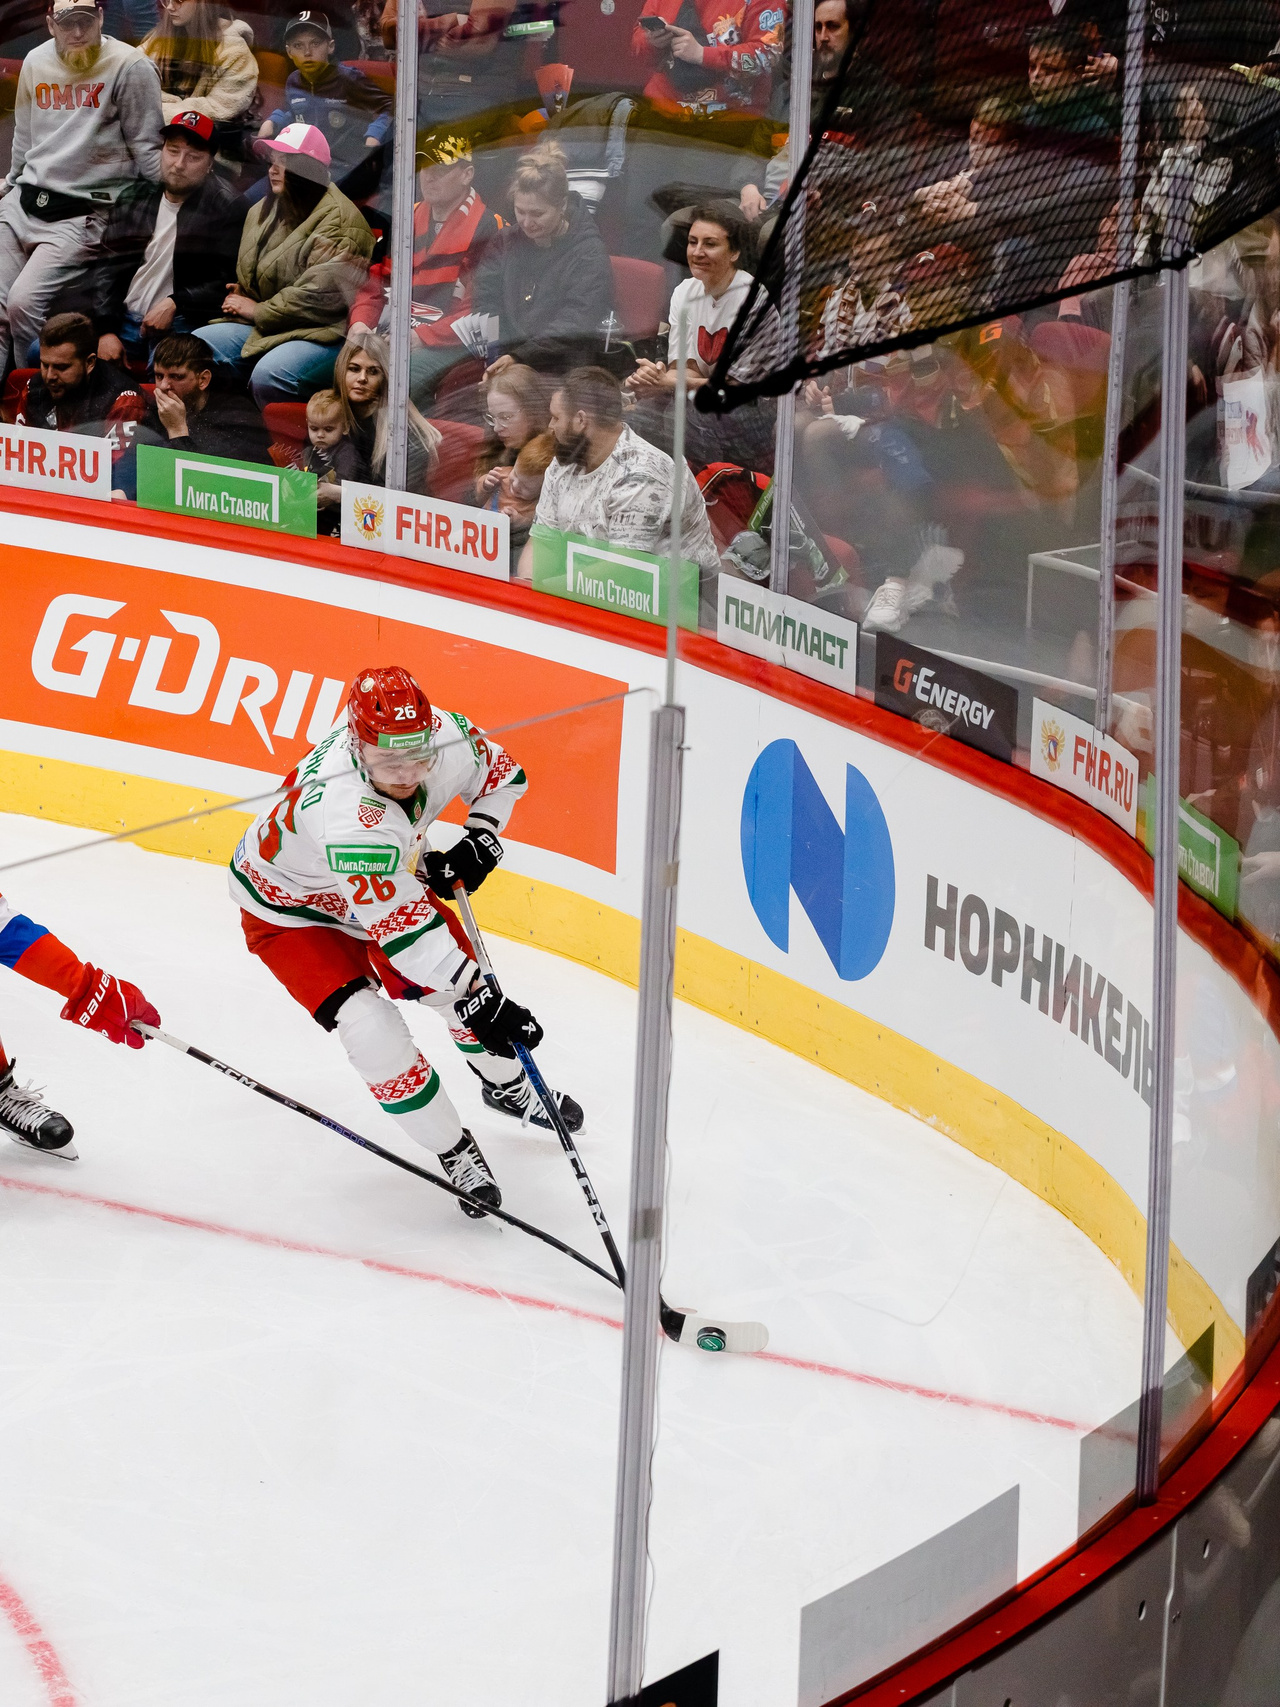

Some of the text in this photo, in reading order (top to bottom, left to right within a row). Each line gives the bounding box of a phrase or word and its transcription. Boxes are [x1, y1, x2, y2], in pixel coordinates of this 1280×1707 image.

[395, 505, 500, 562] FHR.RU
[724, 594, 849, 670] ПОЛИПЛАСТ
[394, 705, 417, 721] 26
[1073, 733, 1135, 813] FHR.RU
[347, 874, 396, 905] 26
[79, 971, 110, 1026] BAUE
[459, 986, 493, 1022] UER
[924, 873, 1155, 1109] НОРНИКЕЛЬ
[209, 1060, 259, 1090] CCM
[320, 1116, 366, 1147] RIBCOR
[565, 1149, 609, 1233] CCM
